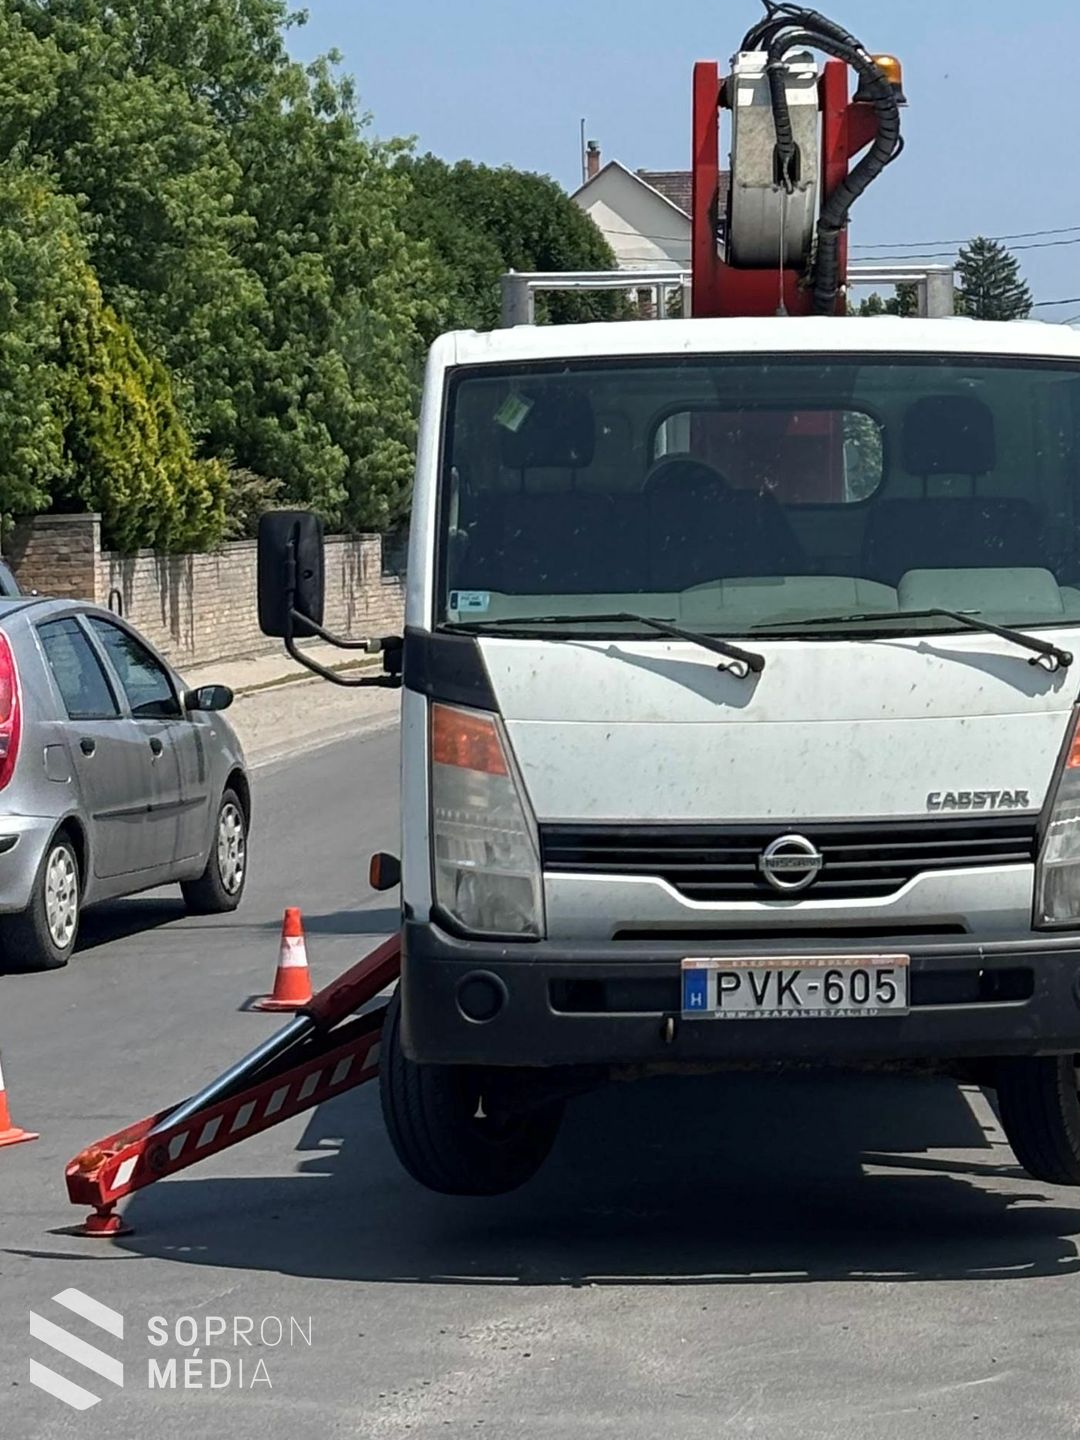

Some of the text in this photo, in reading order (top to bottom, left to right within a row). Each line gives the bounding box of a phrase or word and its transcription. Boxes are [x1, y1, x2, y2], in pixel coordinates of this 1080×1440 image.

[926, 790, 1030, 811] CABSTAR
[765, 858, 819, 868] NISSAN
[716, 968, 897, 1007] PVK-605
[691, 993, 702, 1007] H
